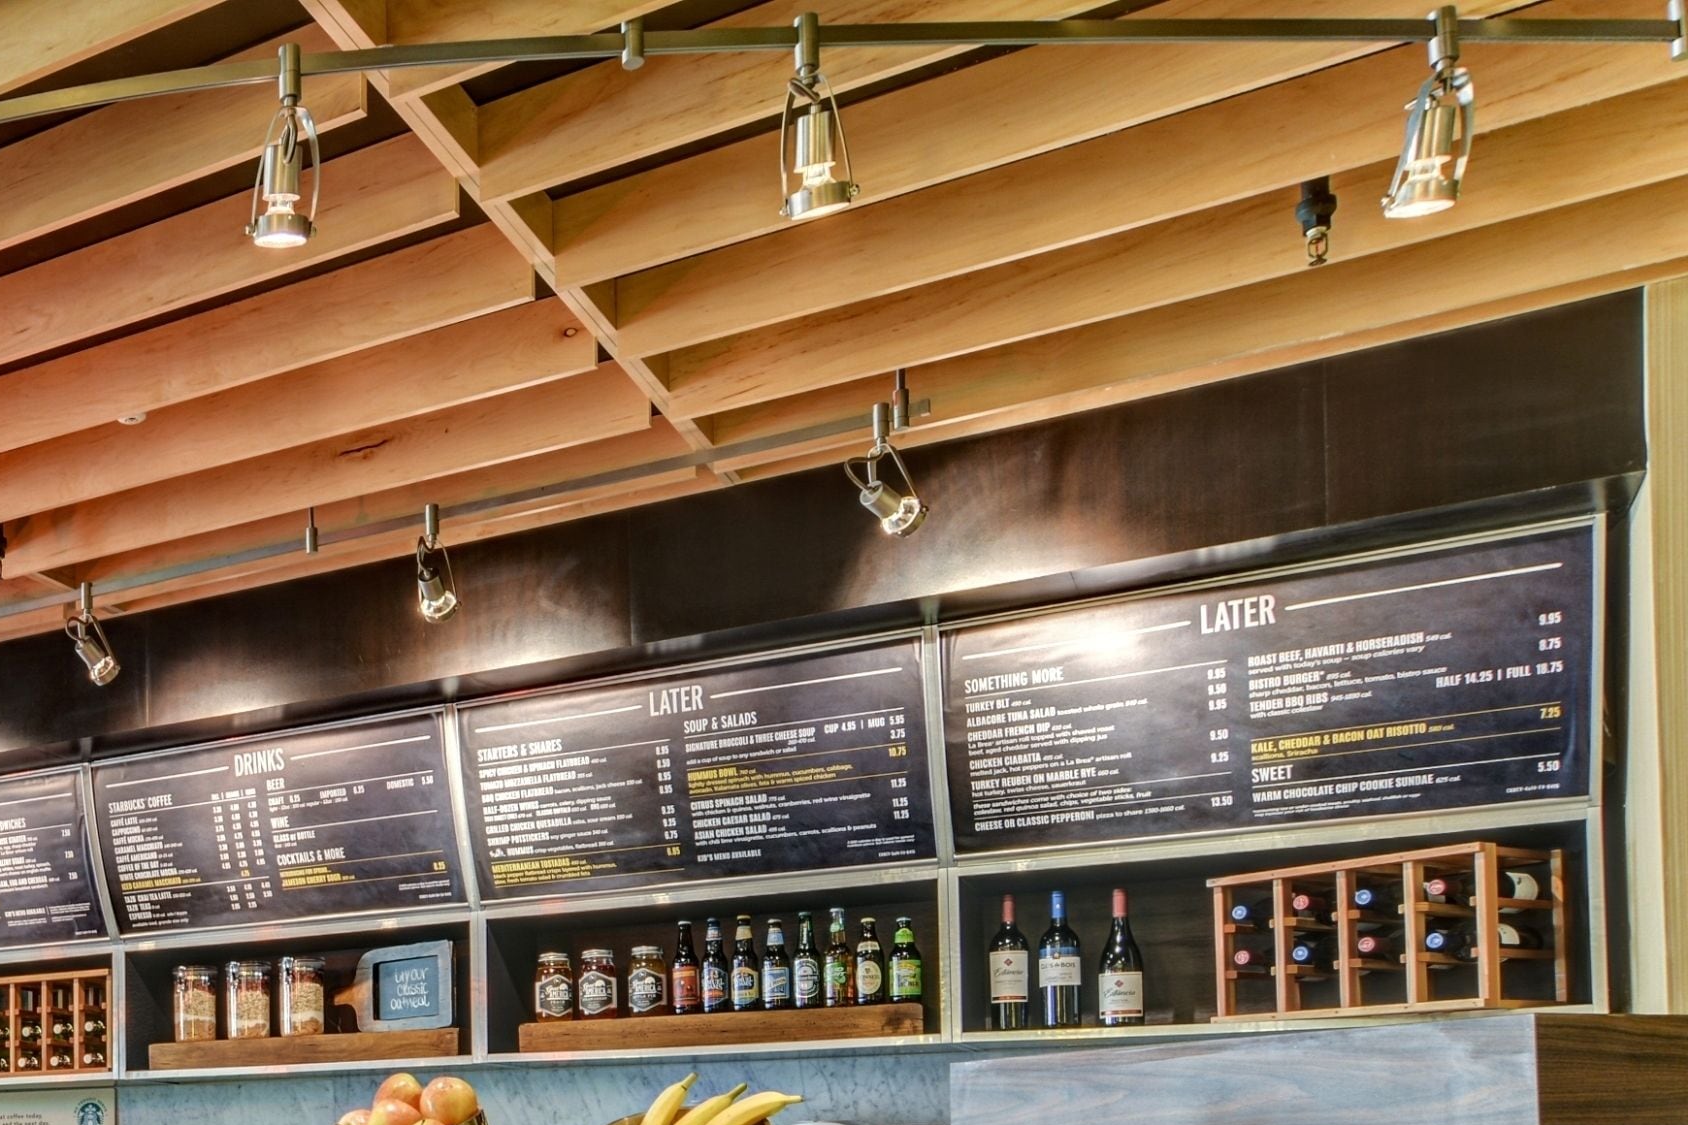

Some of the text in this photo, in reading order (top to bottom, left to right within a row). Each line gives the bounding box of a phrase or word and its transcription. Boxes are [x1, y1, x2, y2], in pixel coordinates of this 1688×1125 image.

[1200, 594, 1275, 634] LATER
[1539, 611, 1561, 625] 9.95
[1247, 632, 1423, 667] ROAST BEEF, HAVARTI & HORSERADISH
[964, 665, 1064, 693] SOMETHING MORE
[1248, 676, 1281, 690] BISTRO
[1435, 674, 1461, 687] HALF
[1464, 669, 1493, 684] 14.25
[1506, 665, 1531, 678] FULL
[648, 684, 703, 716] LATER
[965, 697, 1009, 713] TURKEY BLT
[1249, 691, 1328, 712] TENDER BBQ RIBS
[966, 706, 1056, 727] ALBACORE TUNA SALAD
[1540, 706, 1560, 718] 7.25
[683, 711, 757, 733] SOUP & SALADS
[824, 714, 904, 733] CUP 4.95 MUG 5.95
[967, 721, 1050, 741] CHEDDAR FRENCH DIP
[685, 727, 815, 752] SIGNATURE BROCCOLI & THREE CHEESE SOUP
[890, 728, 905, 739] 3.75
[1209, 728, 1228, 740] 9.50
[1250, 722, 1426, 753] KALE, CHEDDAR & BACON OAT RISOTTO
[477, 738, 562, 762] STARTERS & SHARES
[1210, 751, 1229, 763] 9.25
[233, 747, 284, 776] DRINKS
[969, 752, 1041, 769] CHICKEN CIABATTA
[1537, 760, 1560, 772] 5.50
[687, 767, 737, 781] HUMMUS BOWL
[970, 767, 1096, 790] TURKEY REUBEN ON MARBLE RYE
[1251, 764, 1293, 782] SWEET
[266, 777, 284, 791] BEER
[1252, 790, 1281, 802] WARM
[1282, 784, 1333, 799] CHOCOLATE
[1335, 781, 1358, 793] CHIP
[1359, 778, 1393, 791] COOKIE
[1395, 773, 1433, 787] SUNDAE
[147, 793, 172, 808] COFFEE
[690, 793, 767, 810] CITRUS SPINACH SALAD
[1210, 795, 1233, 807] 13.50
[270, 815, 289, 828] WINE
[692, 811, 771, 828] CHICKEN CAESAR SALAD
[974, 810, 1094, 831] CHEESE OR CLASSIC PEPPERONI
[694, 824, 767, 839] ASIAN CHICKEN SALAD
[276, 847, 345, 865] COCKTAILS & MORE
